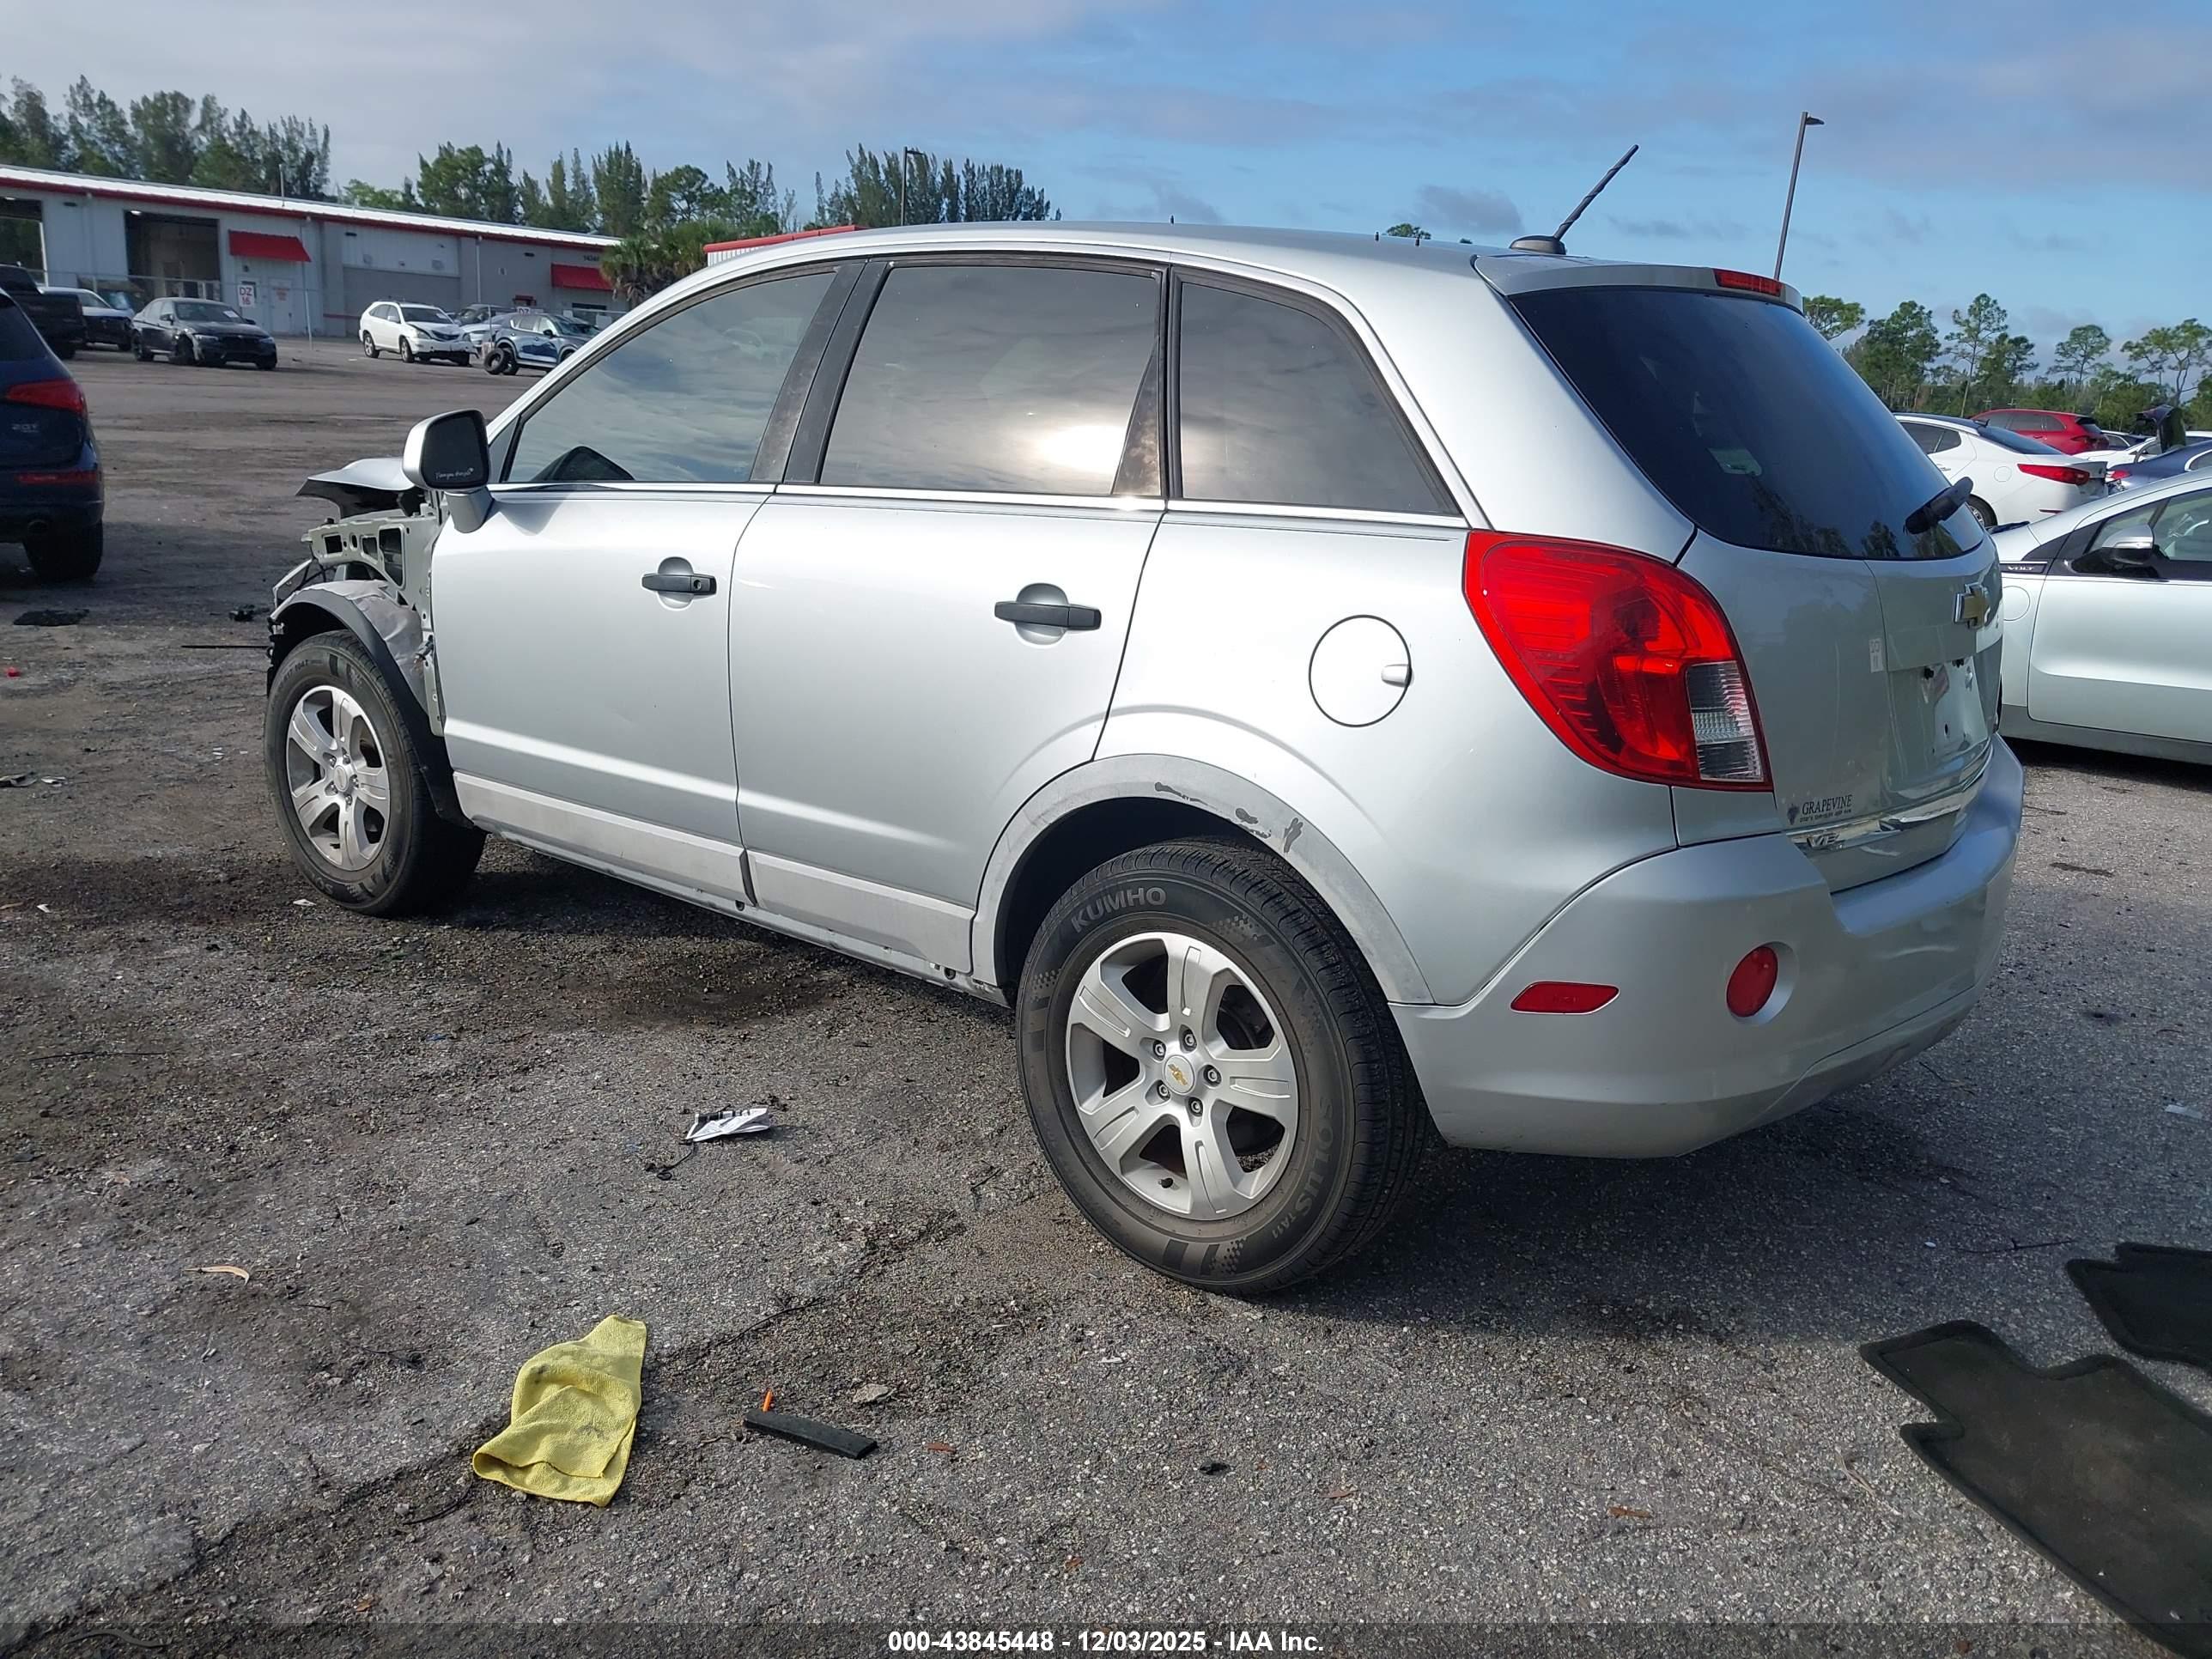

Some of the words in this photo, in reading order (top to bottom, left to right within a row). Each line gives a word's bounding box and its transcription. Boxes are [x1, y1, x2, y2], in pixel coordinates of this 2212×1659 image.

[240, 287, 252, 296] DZ
[241, 296, 252, 306] 16
[1802, 794, 1853, 816] GRAPEVINE
[1071, 886, 1167, 933] KUMHO
[1295, 1097, 1334, 1216] SOLUS
